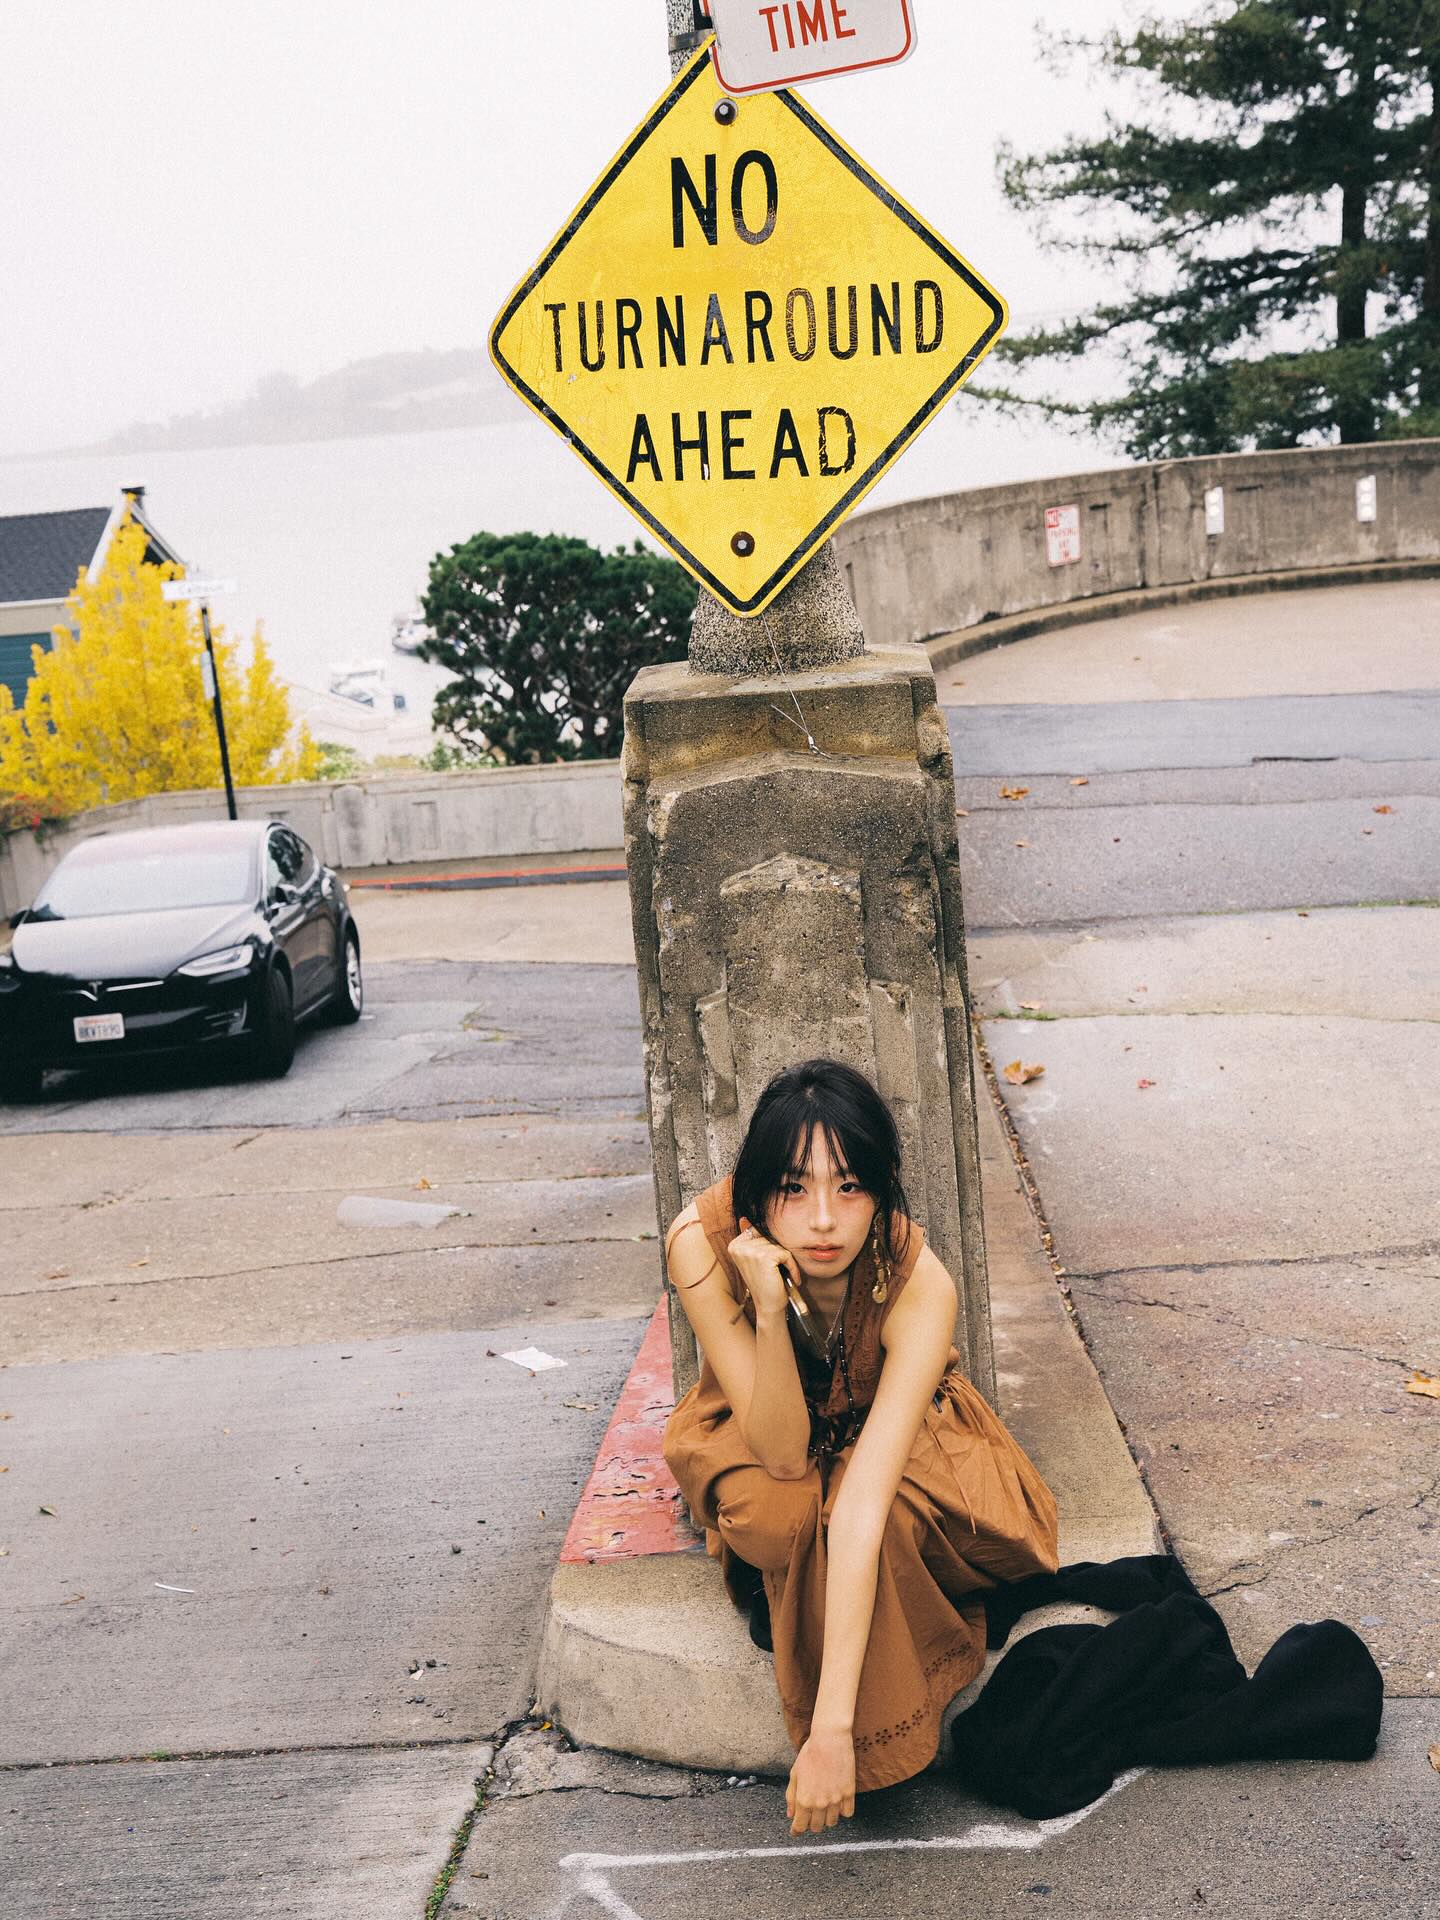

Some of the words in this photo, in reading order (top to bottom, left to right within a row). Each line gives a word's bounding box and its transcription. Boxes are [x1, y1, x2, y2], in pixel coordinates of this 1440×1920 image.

[758, 0, 857, 52] TIME
[671, 150, 779, 248] NO
[544, 280, 944, 373] TURNAROUND
[626, 406, 858, 483] AHEAD
